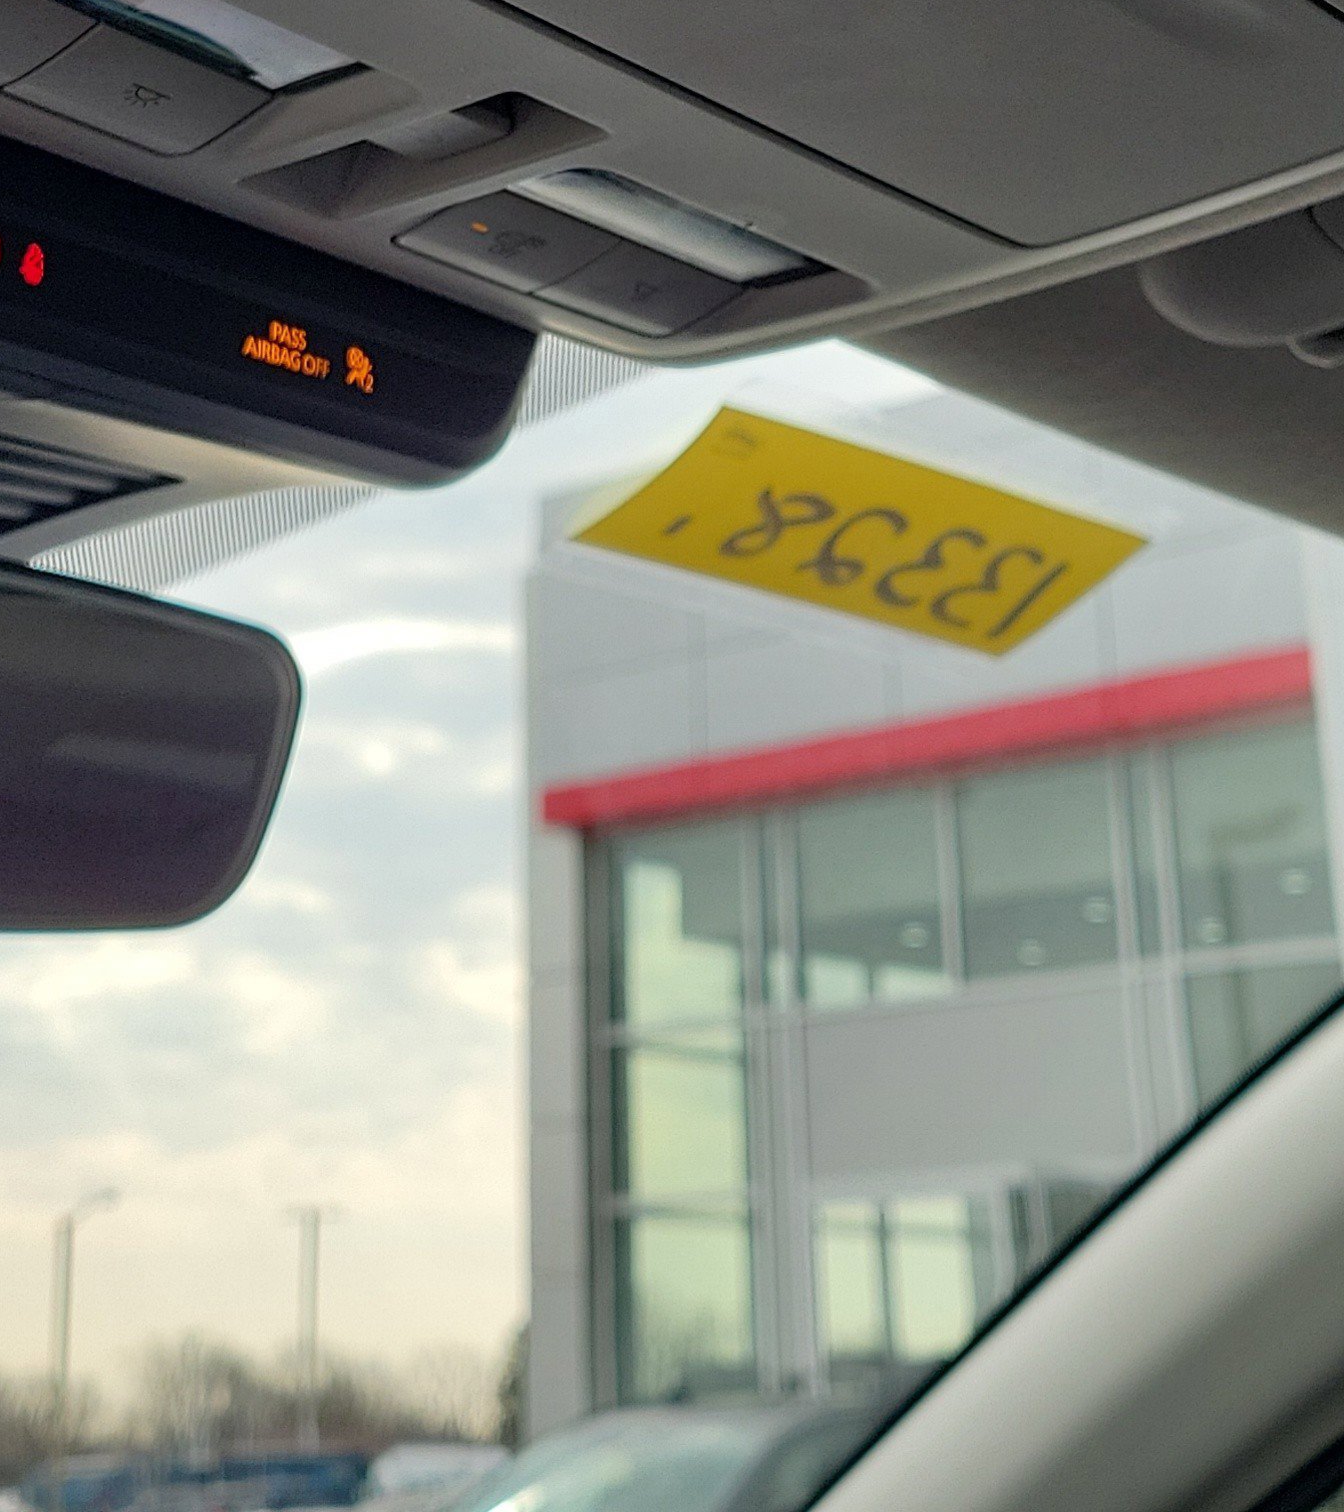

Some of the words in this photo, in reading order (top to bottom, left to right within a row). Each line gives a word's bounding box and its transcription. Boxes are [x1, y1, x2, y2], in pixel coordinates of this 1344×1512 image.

[268, 320, 307, 350] PASS
[241, 335, 301, 373] AIRBAG
[302, 353, 331, 380] OFF
